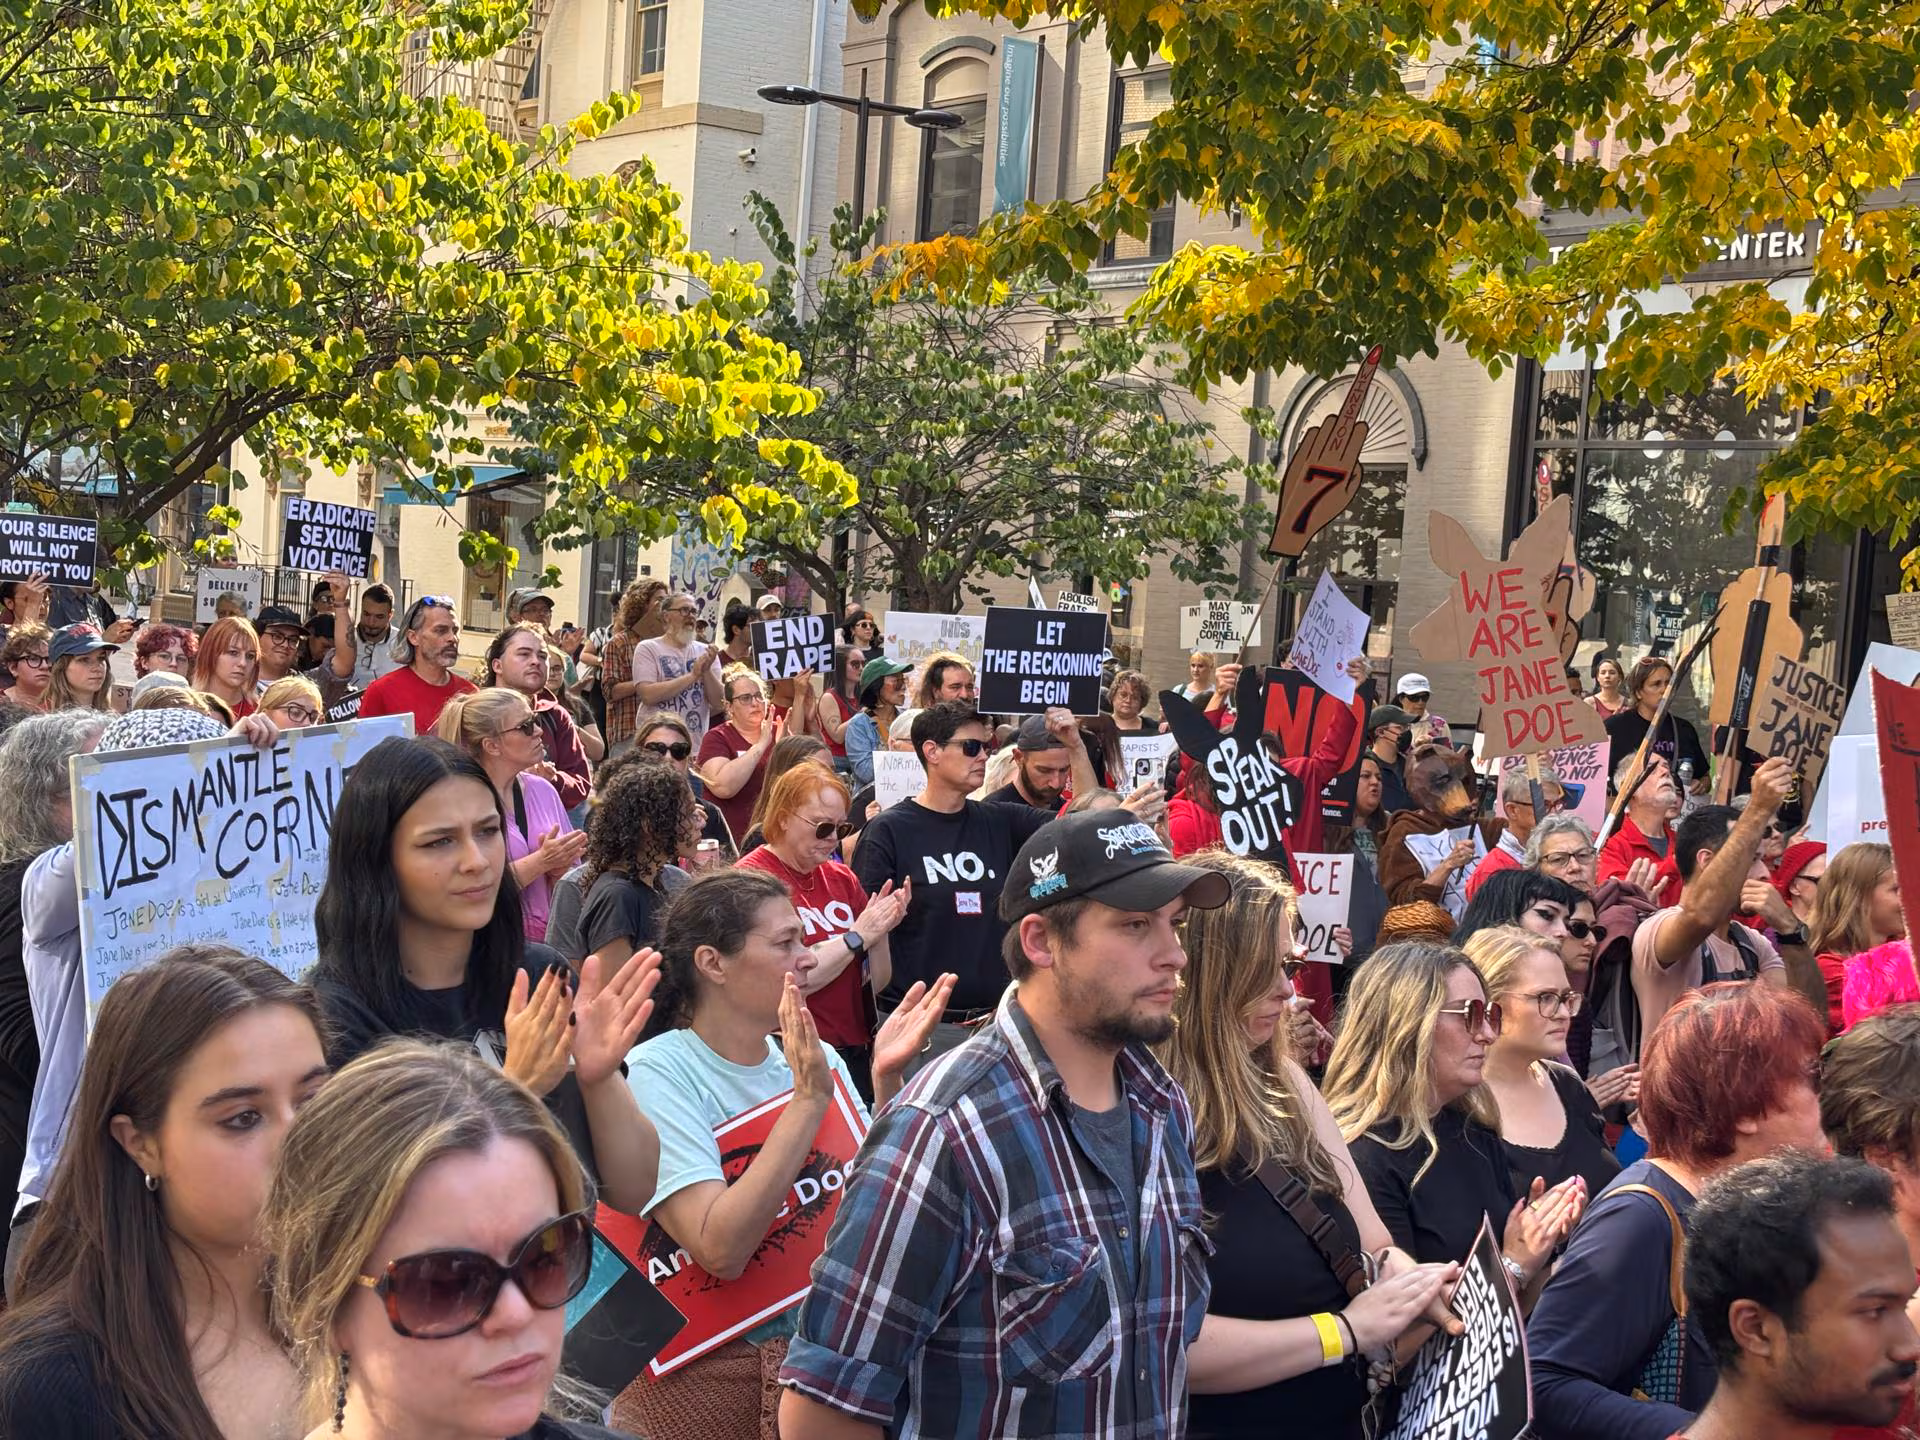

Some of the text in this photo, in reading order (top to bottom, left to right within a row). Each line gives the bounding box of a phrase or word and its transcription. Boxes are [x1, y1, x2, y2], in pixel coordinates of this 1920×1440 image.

[1003, 44, 1015, 85] Imagine
[999, 106, 1010, 168] possibilities
[287, 498, 376, 533] ERADICATE
[1291, 465, 1349, 534] 7
[37, 521, 96, 543] SILENCE
[300, 523, 362, 554] SEXUAL
[9, 539, 79, 560] WILL NOT
[288, 545, 367, 577] VIOLENCE
[0, 558, 91, 581] ROTECT YOU
[208, 580, 249, 592] BELIEVE
[1059, 591, 1099, 607] ABOLISH
[1208, 601, 1231, 612] MAY
[1460, 567, 1529, 614] WE
[765, 616, 826, 650] END
[1036, 620, 1067, 646] LET
[1201, 619, 1233, 631] SMITE
[1209, 611, 1230, 621] RBG
[1308, 600, 1335, 636] STAND
[1633, 593, 1643, 645] EXHIBITION
[1663, 628, 1682, 638] WATER
[1199, 629, 1241, 641] CORNELL
[1214, 640, 1225, 650] 7!
[1303, 620, 1329, 657] WITH
[1468, 608, 1543, 659] ARE
[758, 646, 833, 680] RAPE
[984, 648, 1021, 674] THE
[1021, 650, 1103, 678] RECKONING
[1020, 679, 1071, 706] BEGIN
[1477, 656, 1568, 705] JANE
[1771, 655, 1845, 722] JUSTICE
[1502, 700, 1584, 750] DOE
[1759, 697, 1833, 759] JANE
[1502, 749, 1600, 771] EXIENCE
[1768, 730, 1813, 775] DOE
[1206, 736, 1288, 806] SPEAK
[1568, 764, 1603, 781] NOT
[96, 746, 293, 901] DISMANTLE
[214, 765, 350, 880] CORN
[1219, 782, 1294, 856] OUT!
[1860, 820, 1888, 834] pre
[922, 851, 996, 885] NO.
[1456, 1282, 1503, 1377] EVERY
